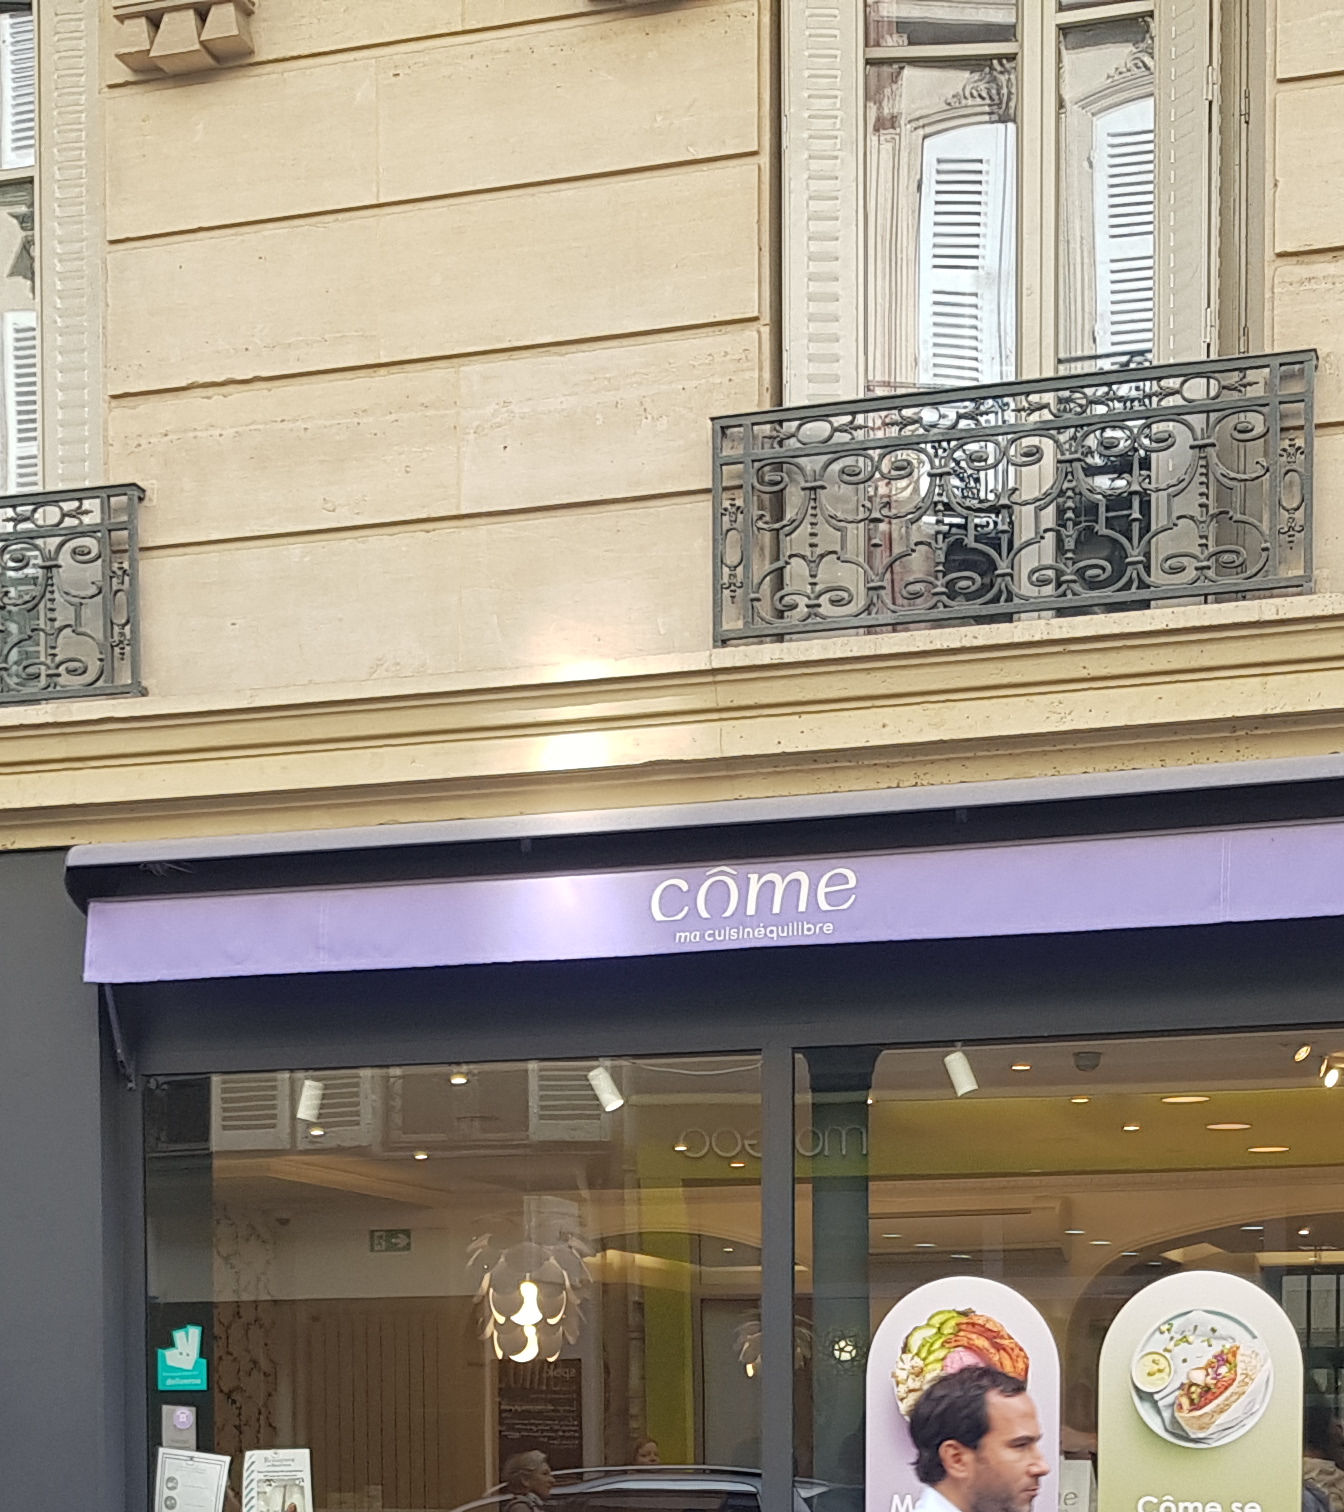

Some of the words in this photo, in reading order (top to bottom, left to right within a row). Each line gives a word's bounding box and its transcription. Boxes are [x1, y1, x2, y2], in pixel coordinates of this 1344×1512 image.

[651, 866, 857, 921] côme
[675, 931, 700, 943] ma
[704, 921, 834, 942] cuisinéquilibre
